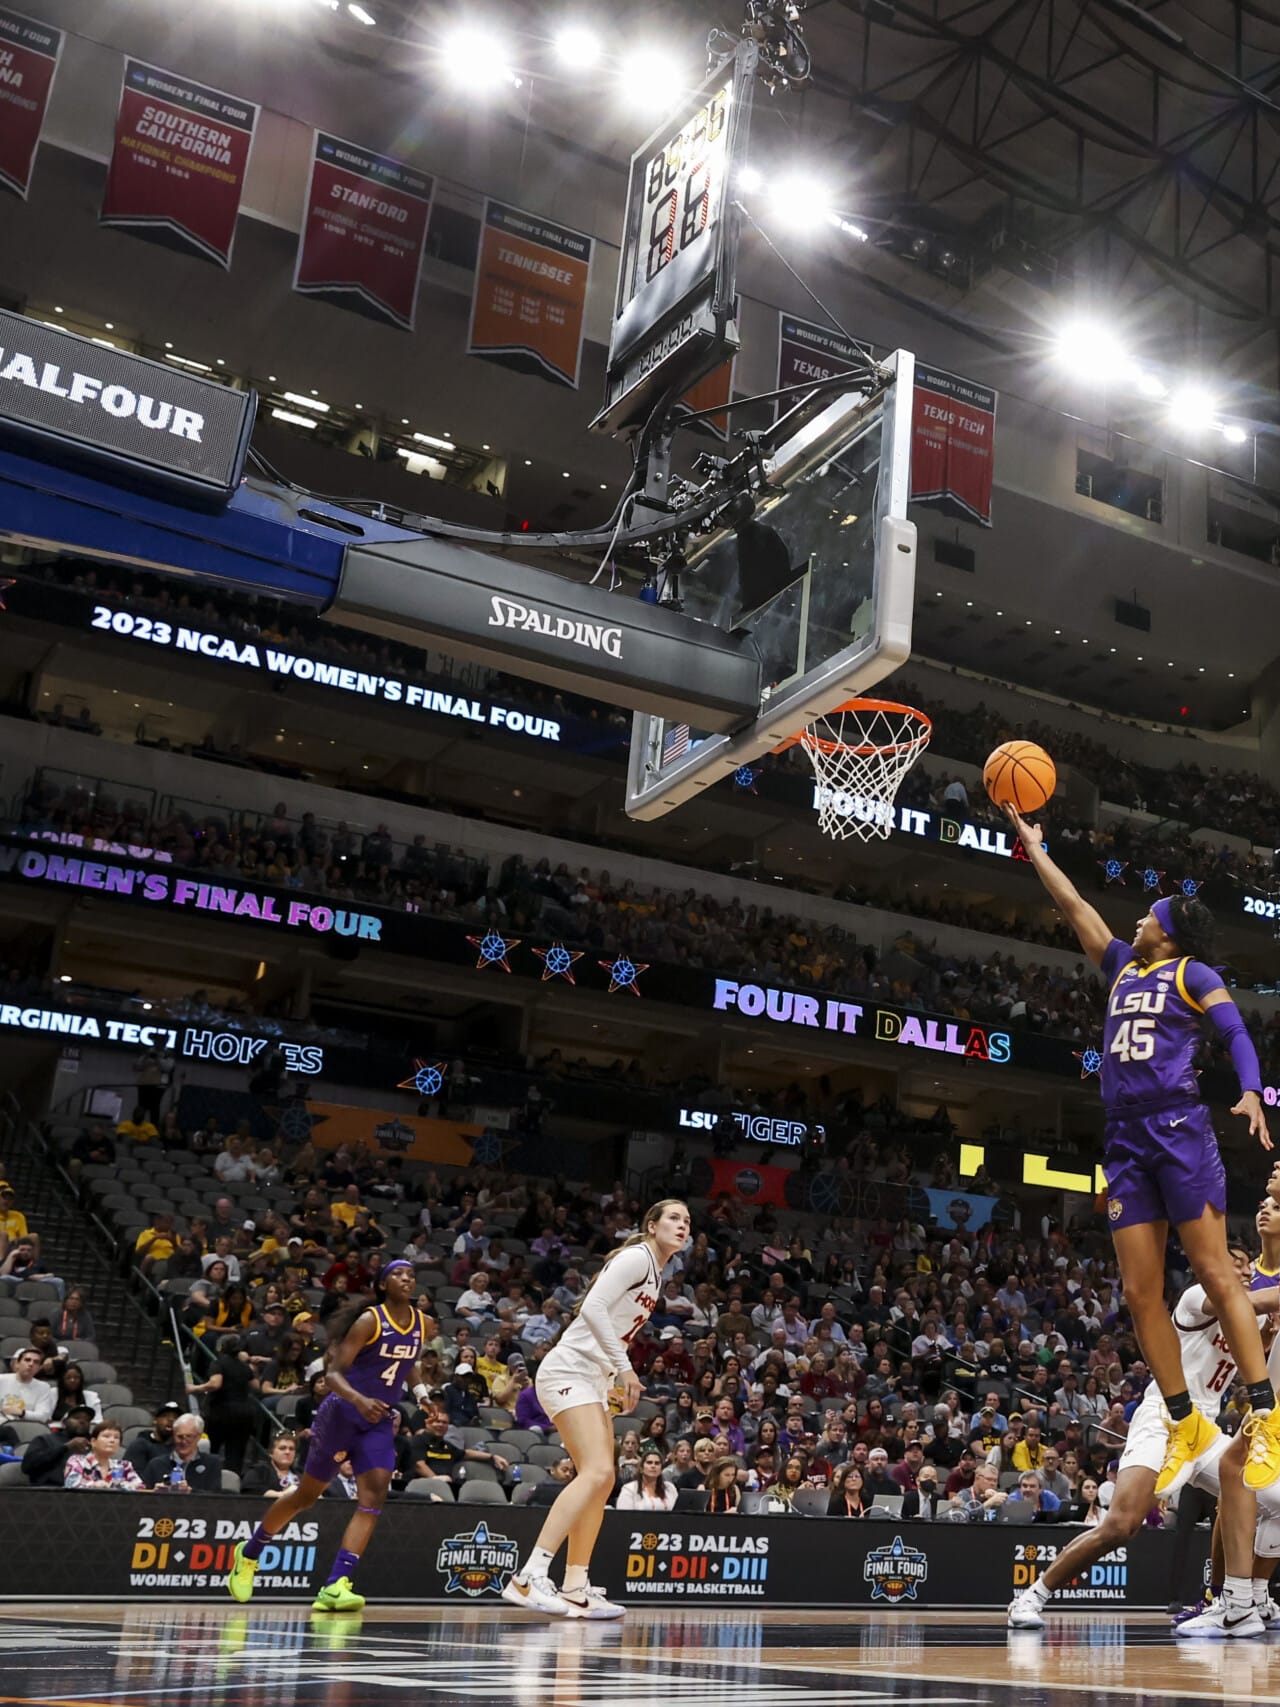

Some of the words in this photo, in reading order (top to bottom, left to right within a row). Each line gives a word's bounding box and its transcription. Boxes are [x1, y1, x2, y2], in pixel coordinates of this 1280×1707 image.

[221, 105, 248, 121] FOUR
[142, 106, 232, 149] SOUTHERN
[136, 121, 232, 165] CALIFORNIA
[330, 184, 408, 223] STANFORD
[497, 248, 574, 286] TENNESSEE
[796, 328, 828, 347] WOMEN'S
[793, 358, 829, 380] TEXAS
[923, 403, 955, 425] TEXAS
[958, 416, 985, 436] TECH
[488, 595, 624, 659] SPALDING
[91, 606, 172, 644] 2023
[175, 627, 261, 667] NCAA
[265, 650, 402, 701] WOMEN'S
[405, 685, 486, 722] FINAL
[490, 706, 561, 742] FOUR
[900, 808, 931, 836] IT
[172, 879, 282, 923] FINAL
[287, 900, 383, 941] FOUR
[1110, 991, 1167, 1017] LSU
[713, 978, 820, 1027] FOUR
[824, 1000, 864, 1034] IT
[875, 1010, 1011, 1063] DALLAS
[183, 1028, 324, 1074] HOKES
[1110, 1018, 1155, 1063] 45
[679, 1109, 718, 1130] LSU
[379, 1343, 418, 1359] LSU
[380, 1361, 400, 1386] 4
[1206, 1358, 1236, 1393] 13
[131, 1543, 170, 1569] DI
[258, 1546, 316, 1571] DIII
[688, 1535, 769, 1554] DALLAS
[440, 1550, 477, 1567] FINAL
[480, 1550, 514, 1569] FOUR
[626, 1554, 656, 1578] DI
[670, 1556, 708, 1579] DII
[722, 1557, 768, 1580] DIII
[866, 1561, 895, 1577] FINAL
[897, 1561, 924, 1578] FOUR
[130, 1574, 206, 1587] WOMEN'S
[625, 1581, 685, 1593] WOMEN'S
[686, 1582, 765, 1595] BASKETBALL
[1091, 1565, 1127, 1586] DIII
[1062, 1589, 1126, 1599] BASKETBALL
